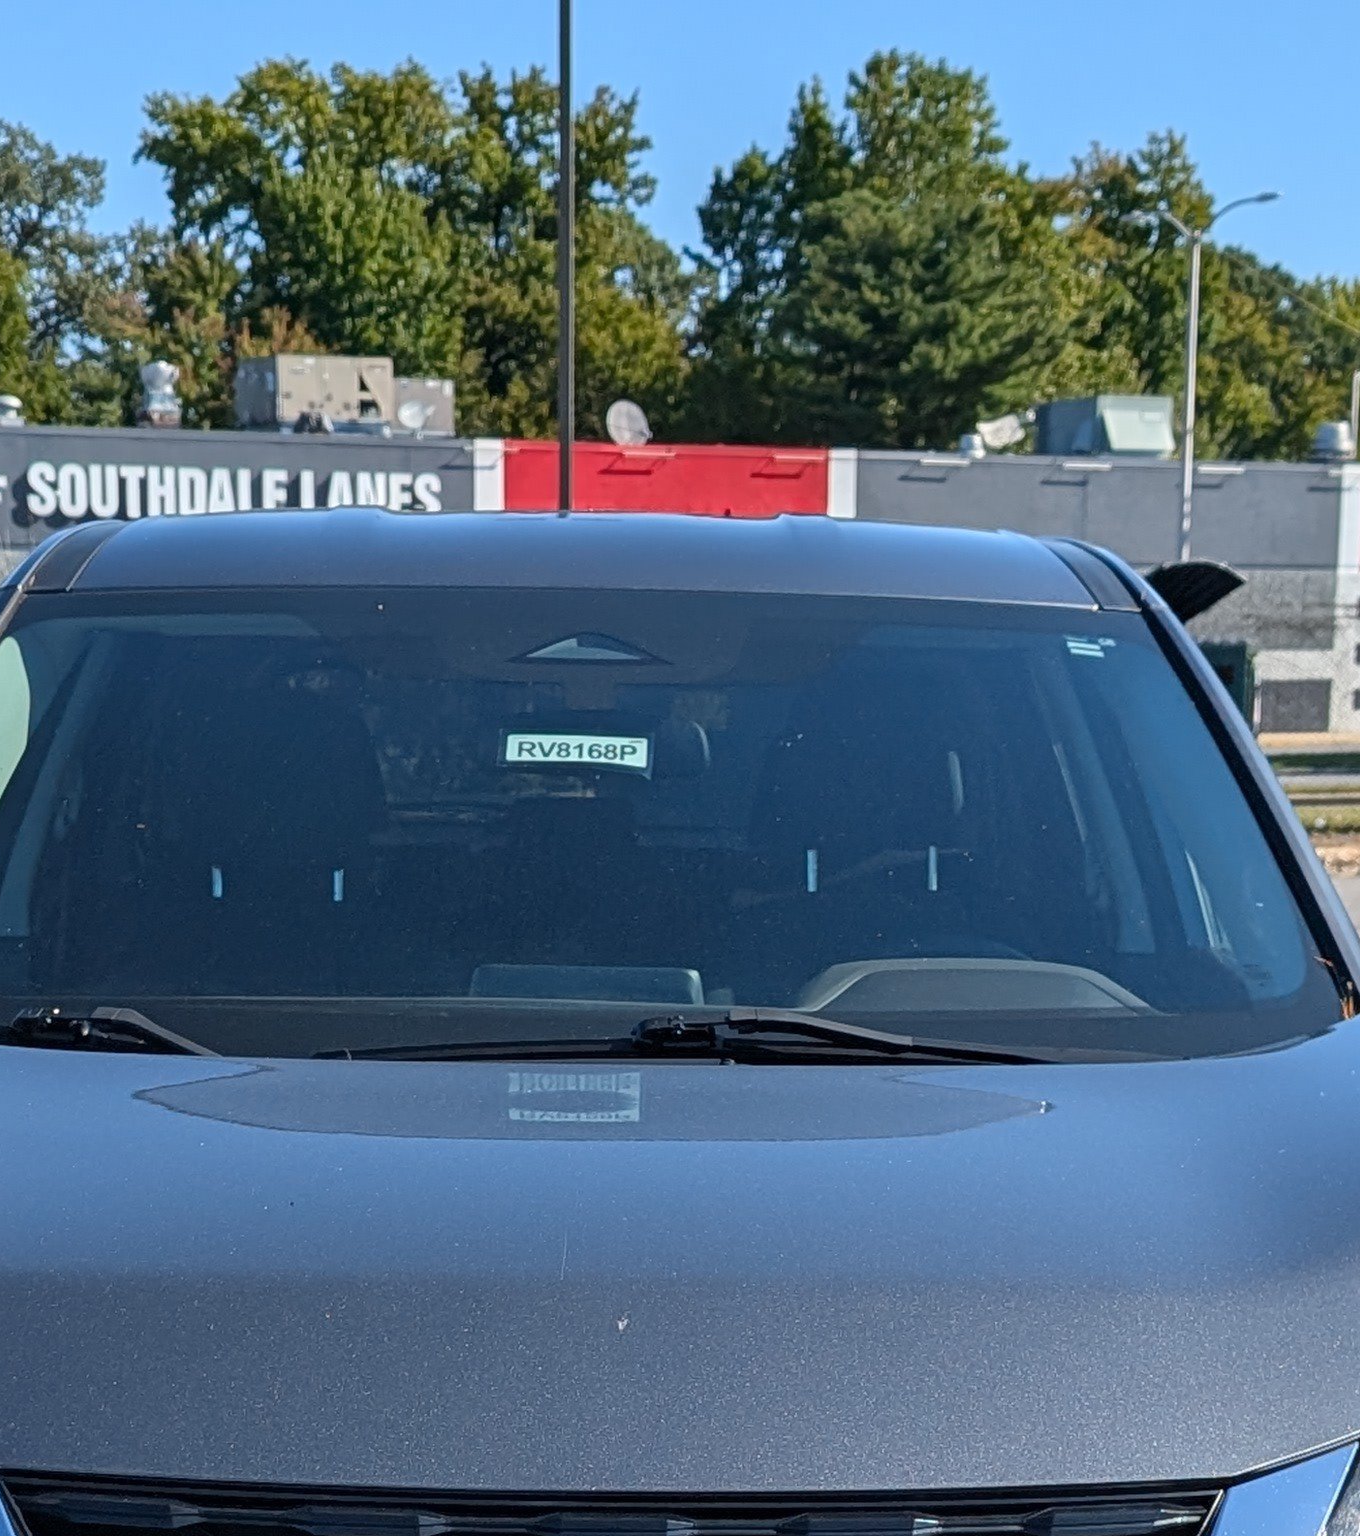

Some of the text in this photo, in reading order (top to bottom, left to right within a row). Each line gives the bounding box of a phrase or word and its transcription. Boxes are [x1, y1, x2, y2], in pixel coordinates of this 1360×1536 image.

[26, 460, 288, 519] SOUTHDALE
[300, 470, 442, 512] LANES
[517, 741, 637, 761] RV8168P
